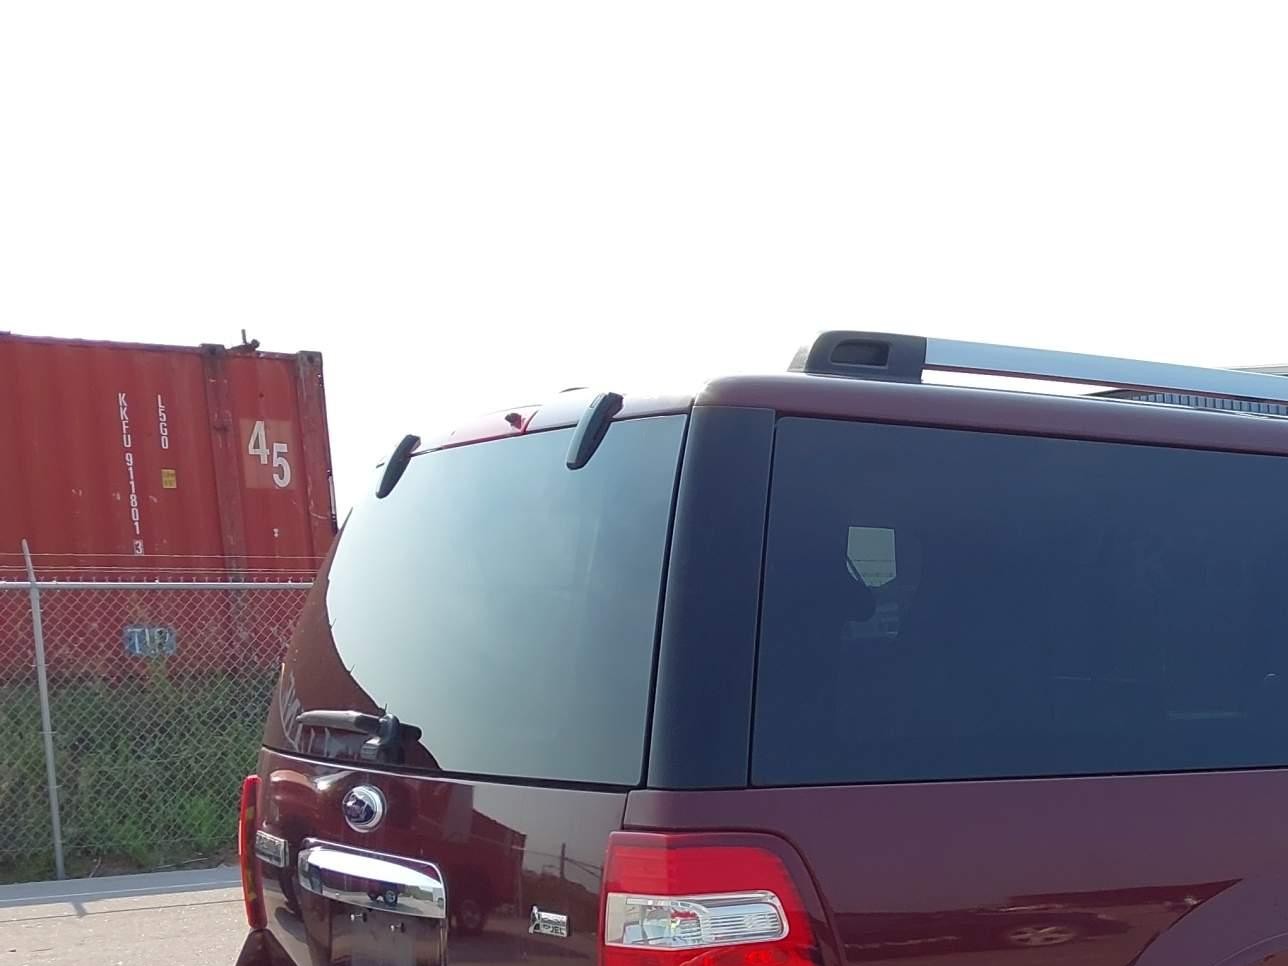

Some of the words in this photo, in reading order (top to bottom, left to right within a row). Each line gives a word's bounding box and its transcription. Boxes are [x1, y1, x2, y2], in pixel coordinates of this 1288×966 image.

[118, 392, 131, 448] KKFU
[125, 452, 141, 536] 911801
[134, 540, 143, 554] 3
[248, 420, 292, 488] 45
